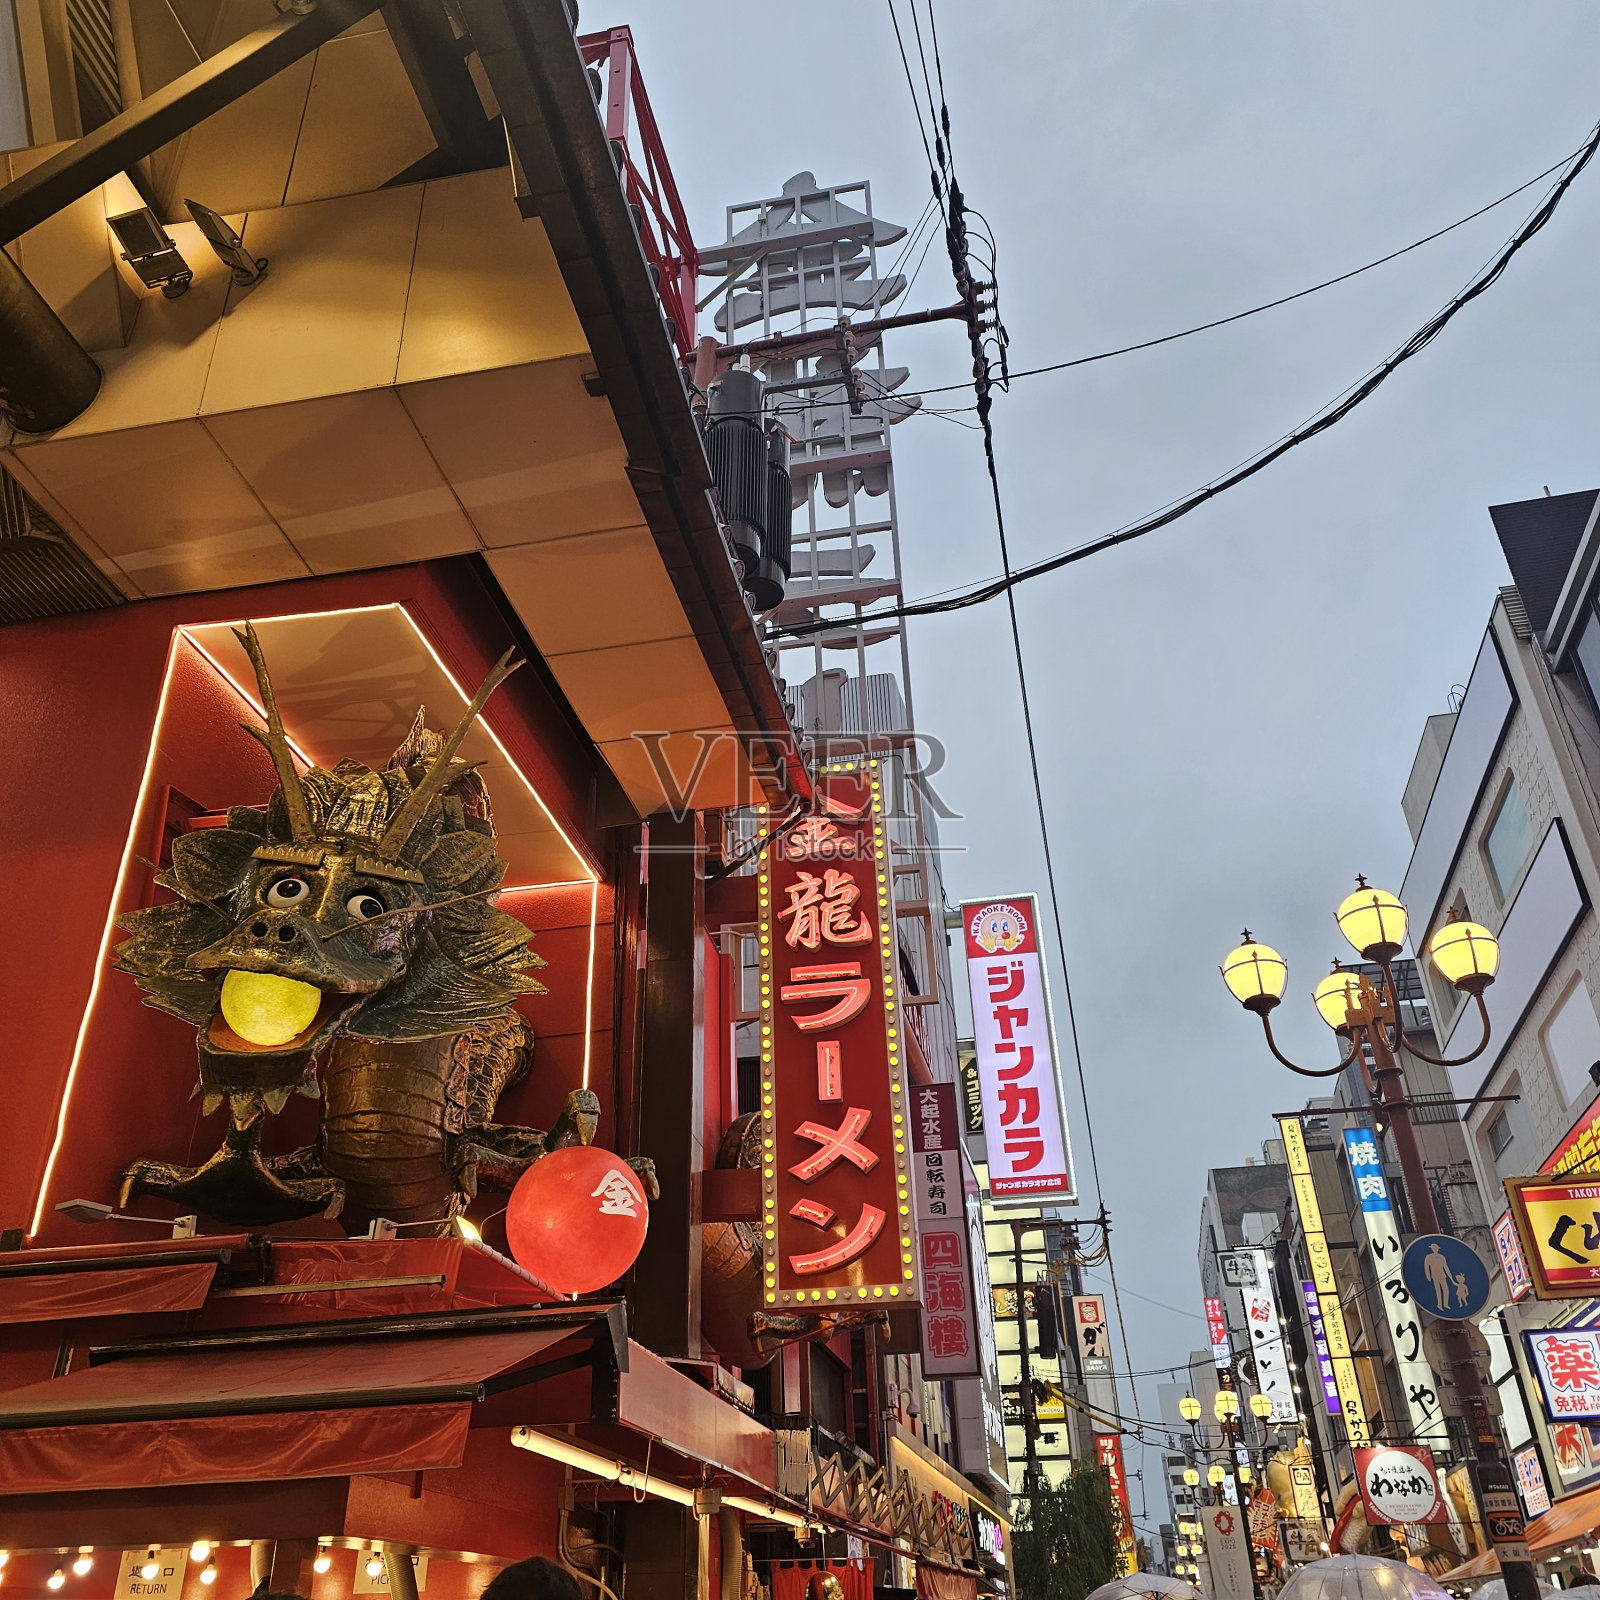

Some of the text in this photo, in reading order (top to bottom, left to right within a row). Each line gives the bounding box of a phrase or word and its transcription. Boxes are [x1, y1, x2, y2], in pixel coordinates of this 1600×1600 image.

[778, 786, 887, 1276] 金龍ラーメン
[987, 960, 1045, 1173] ジャンカラ
[919, 1088, 943, 1150] 大起水産
[590, 1169, 643, 1218] 金
[924, 1153, 947, 1216] 回転寿司
[1349, 1141, 1387, 1200] 焼肉
[1567, 1186, 1600, 1199] TAKOY
[921, 1231, 969, 1359] 四海樓
[1590, 1267, 1600, 1277] 大
[1372, 1235, 1436, 1420] いろりや
[1541, 1335, 1600, 1390] 薬
[1554, 1396, 1590, 1412] 免税
[1370, 1473, 1428, 1498] わなか
[1368, 1501, 1393, 1524] TAKOYAKI
[128, 1564, 175, 1578] 返口
[130, 1583, 168, 1595] RETURN
